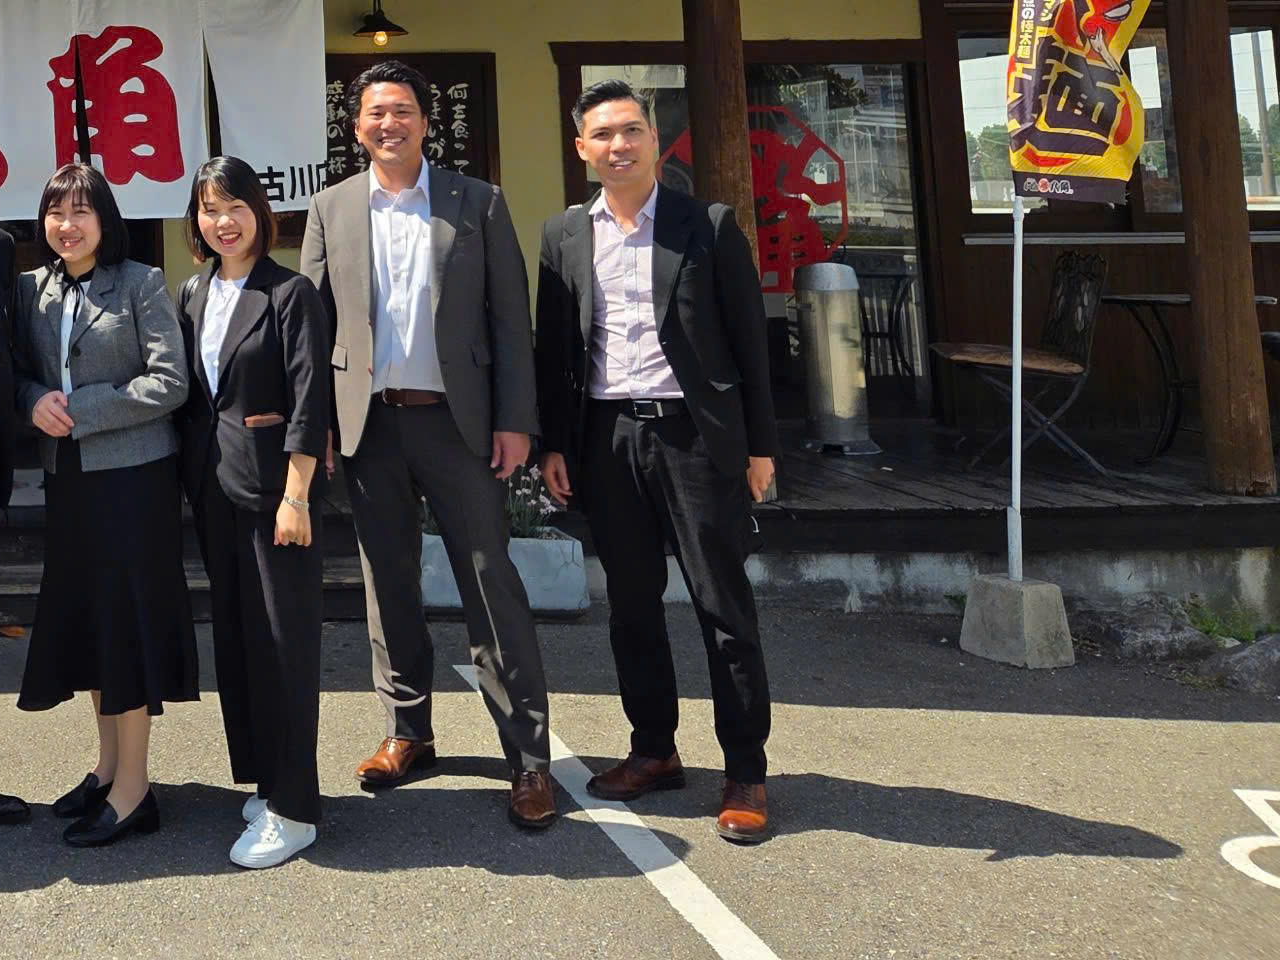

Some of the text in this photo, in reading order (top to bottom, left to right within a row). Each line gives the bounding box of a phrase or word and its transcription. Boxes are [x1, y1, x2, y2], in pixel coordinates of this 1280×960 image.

[327, 80, 347, 175] 感動の一杯
[447, 82, 470, 176] 何を食って
